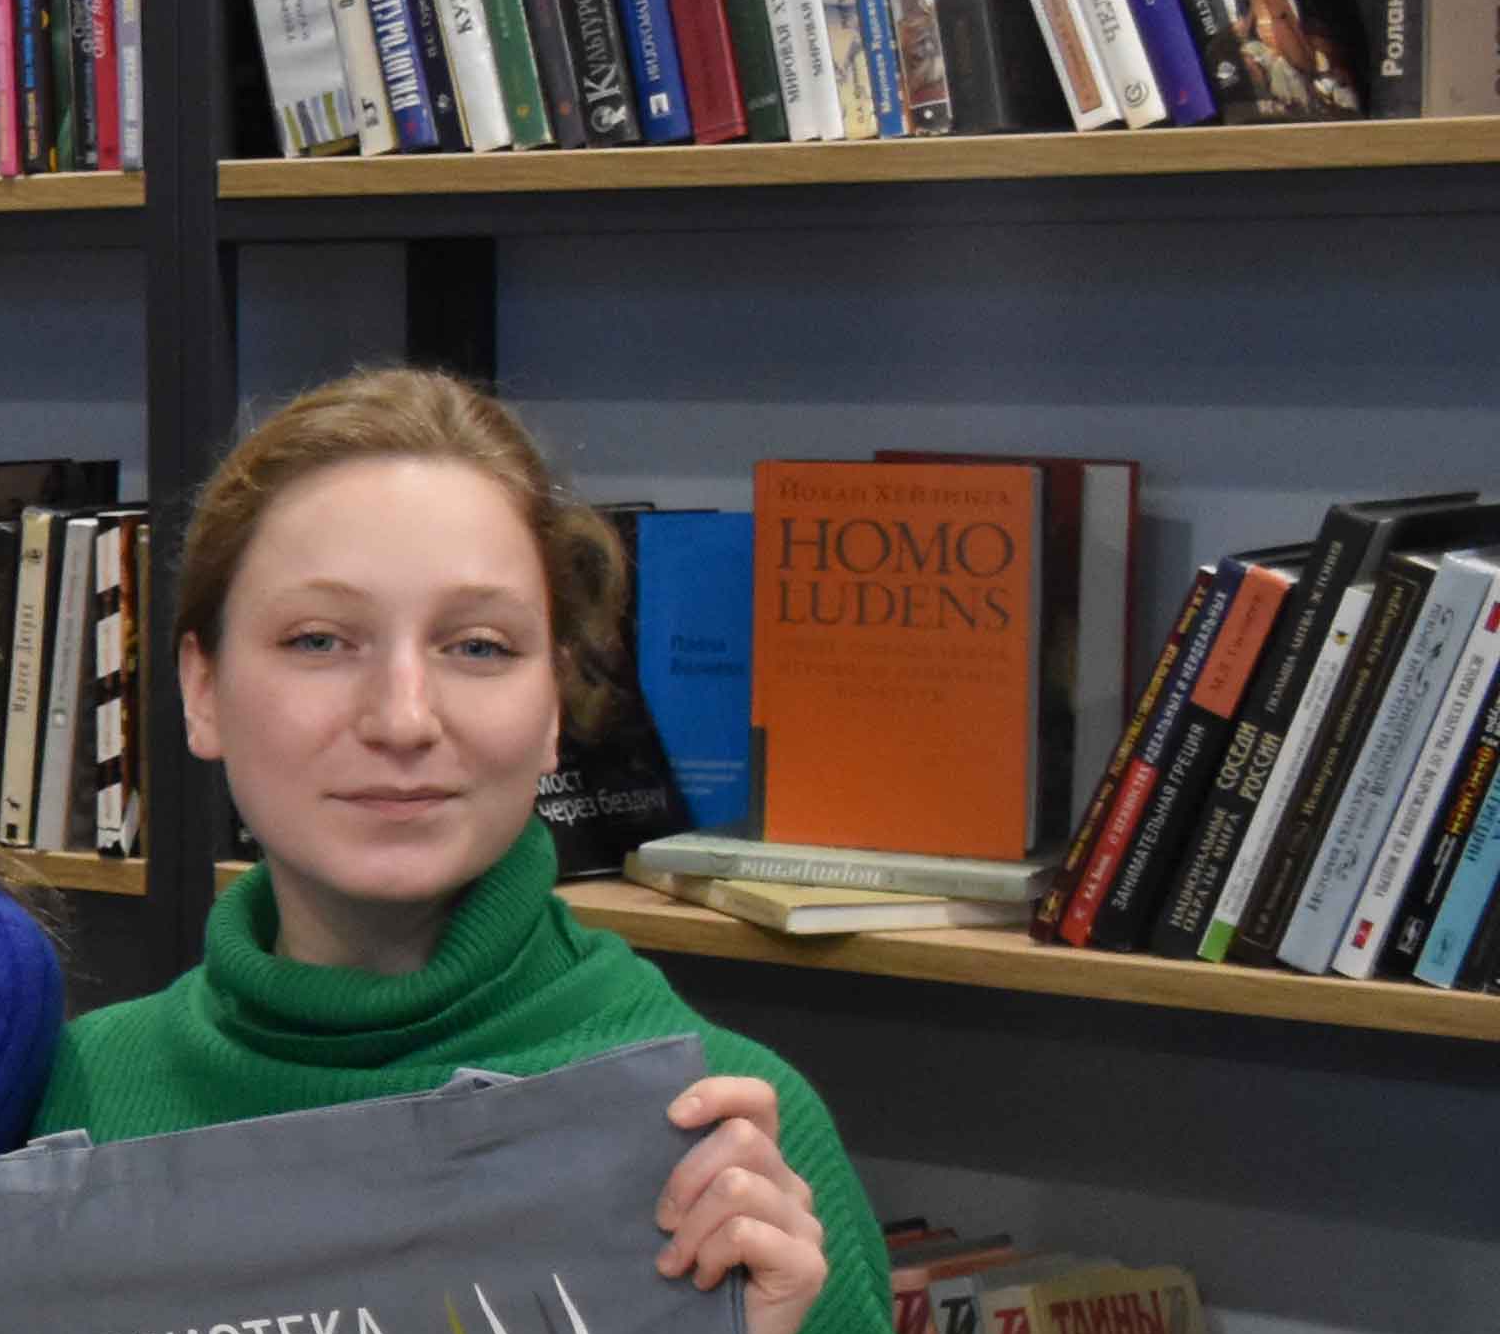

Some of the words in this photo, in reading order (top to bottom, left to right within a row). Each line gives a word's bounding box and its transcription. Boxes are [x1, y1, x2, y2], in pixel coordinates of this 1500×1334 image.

[777, 24, 801, 103] МИРОВАЯ
[779, 517, 1015, 578] HOMO
[778, 580, 1011, 629] LUDENS
[1215, 721, 1258, 790] СОСЕДИ
[1239, 732, 1282, 800] РОССИИ
[1111, 785, 1177, 910] ЗАНИМАТЕЛЬНАЯ
[1167, 723, 1204, 784] ГРЕЦИЯ
